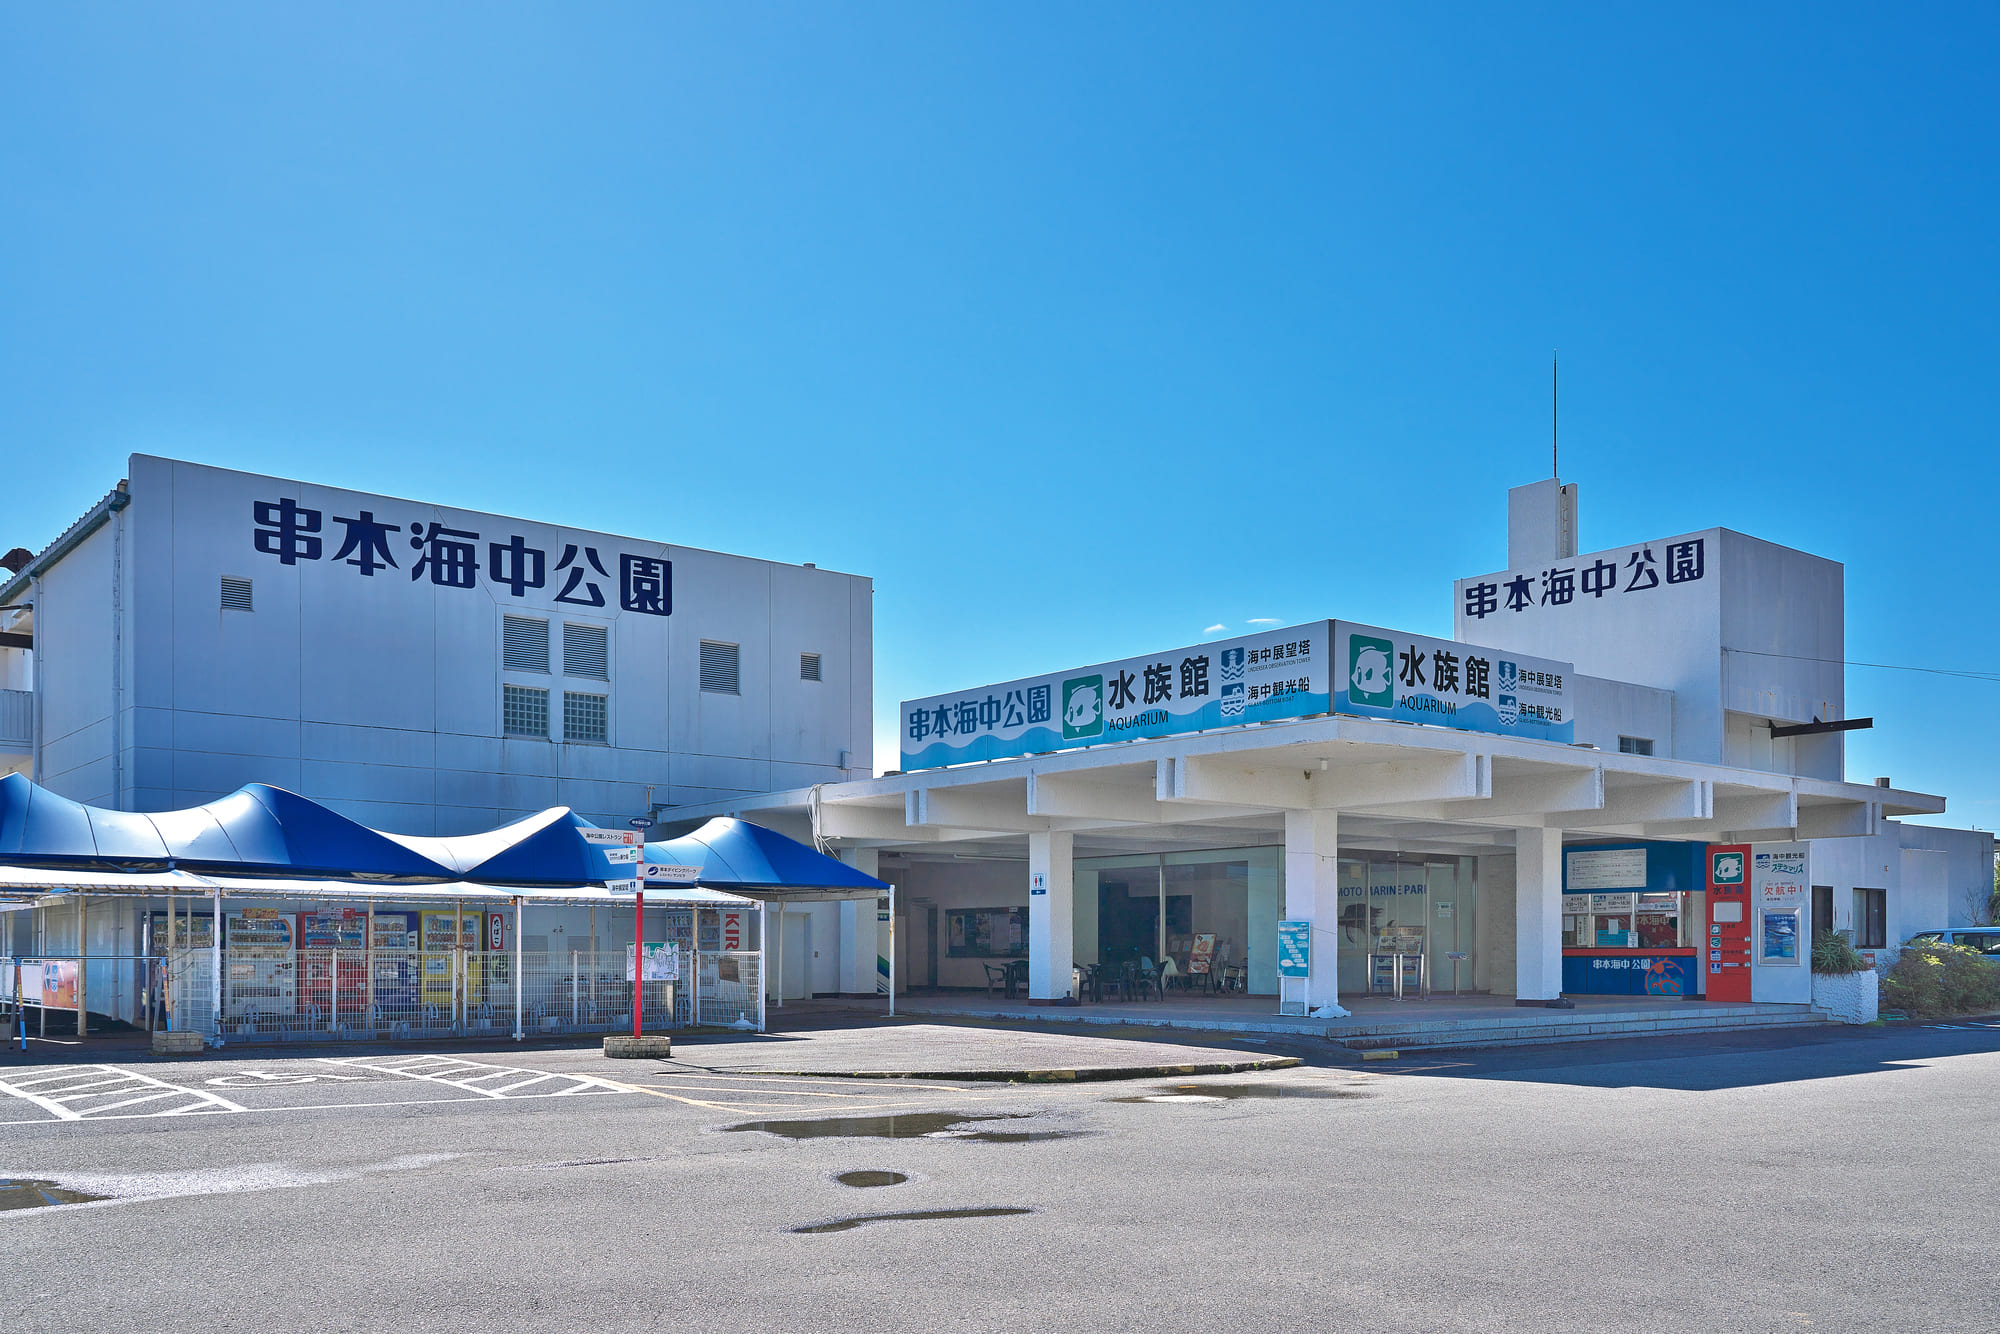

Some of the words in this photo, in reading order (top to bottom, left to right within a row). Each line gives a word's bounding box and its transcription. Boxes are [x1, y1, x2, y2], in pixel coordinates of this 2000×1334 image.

[254, 498, 672, 616] 串本海中公園
[1465, 538, 1704, 619] 串本海中公園
[1247, 640, 1311, 665] 海中展望塔
[1108, 655, 1209, 710] 水族館
[1399, 645, 1490, 700] 水族館
[1518, 668, 1562, 689] 海中展望塔
[1247, 676, 1310, 700] 海中観光船
[909, 684, 1051, 742] 串本海中公園
[1400, 694, 1457, 716] AQUARIUM
[1518, 702, 1562, 722] 海中観光船
[1108, 710, 1169, 731] AQUARIUM
[1592, 958, 1651, 970] 串本海中公園
